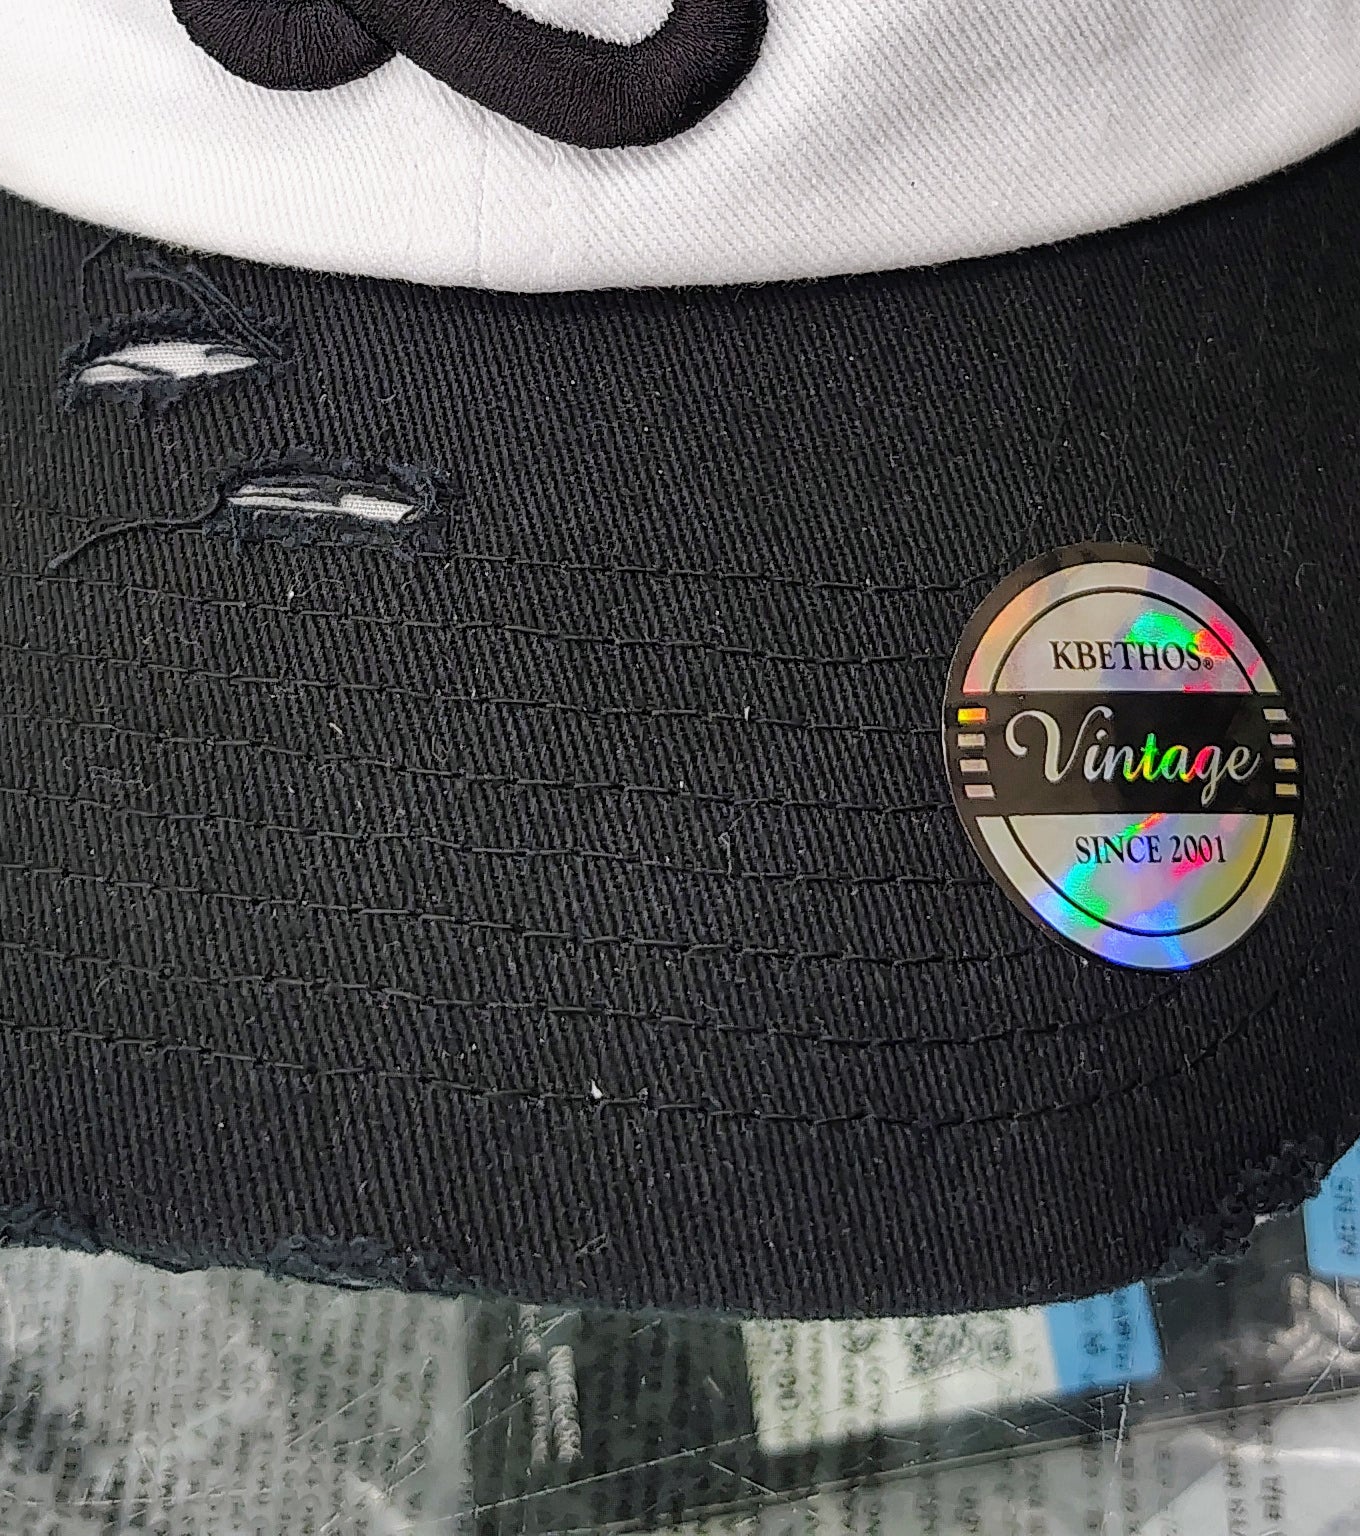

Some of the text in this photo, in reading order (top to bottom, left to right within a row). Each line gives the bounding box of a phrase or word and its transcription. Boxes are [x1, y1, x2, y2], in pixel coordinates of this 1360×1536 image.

[1004, 704, 1262, 807] Vintage
[1075, 834, 1228, 865] SINCE 2001
